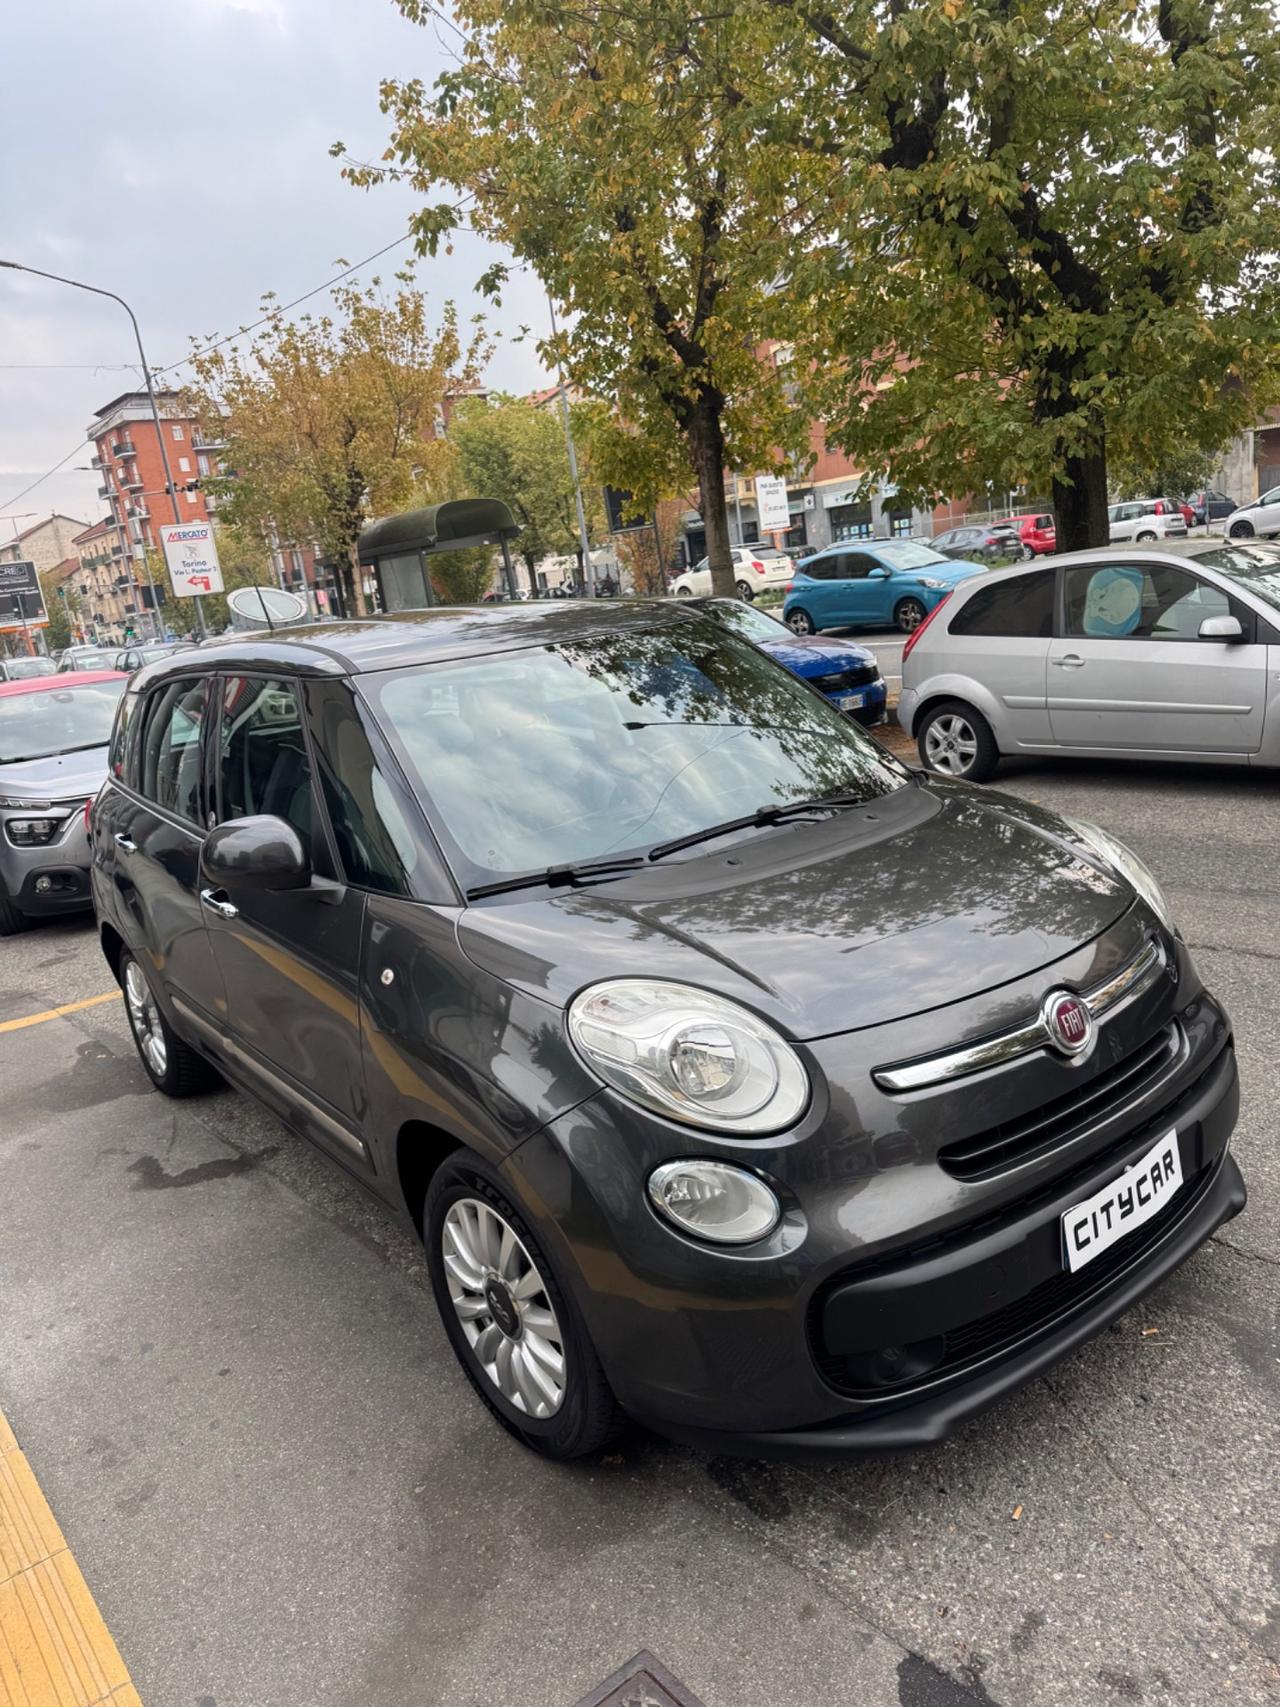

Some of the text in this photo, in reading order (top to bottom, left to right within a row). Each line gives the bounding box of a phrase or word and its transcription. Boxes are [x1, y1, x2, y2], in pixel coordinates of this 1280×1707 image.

[181, 560, 207, 568] Torino
[1061, 1008, 1083, 1037] FIAT
[1073, 1149, 1175, 1251] CITYCAR
